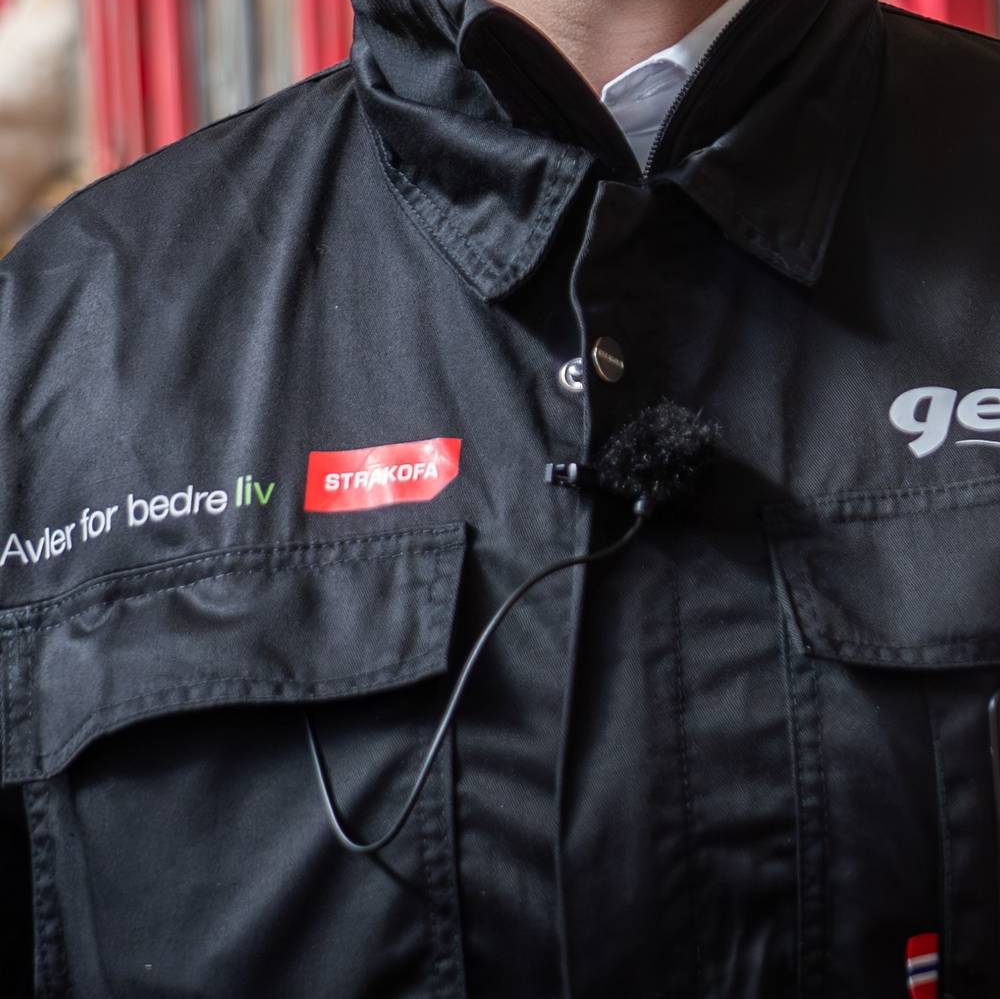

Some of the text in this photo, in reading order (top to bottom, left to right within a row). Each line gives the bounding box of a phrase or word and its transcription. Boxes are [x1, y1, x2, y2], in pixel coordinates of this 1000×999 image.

[324, 462, 438, 492] STRAKOFA
[0, 474, 276, 567] Avler for bedre liv
